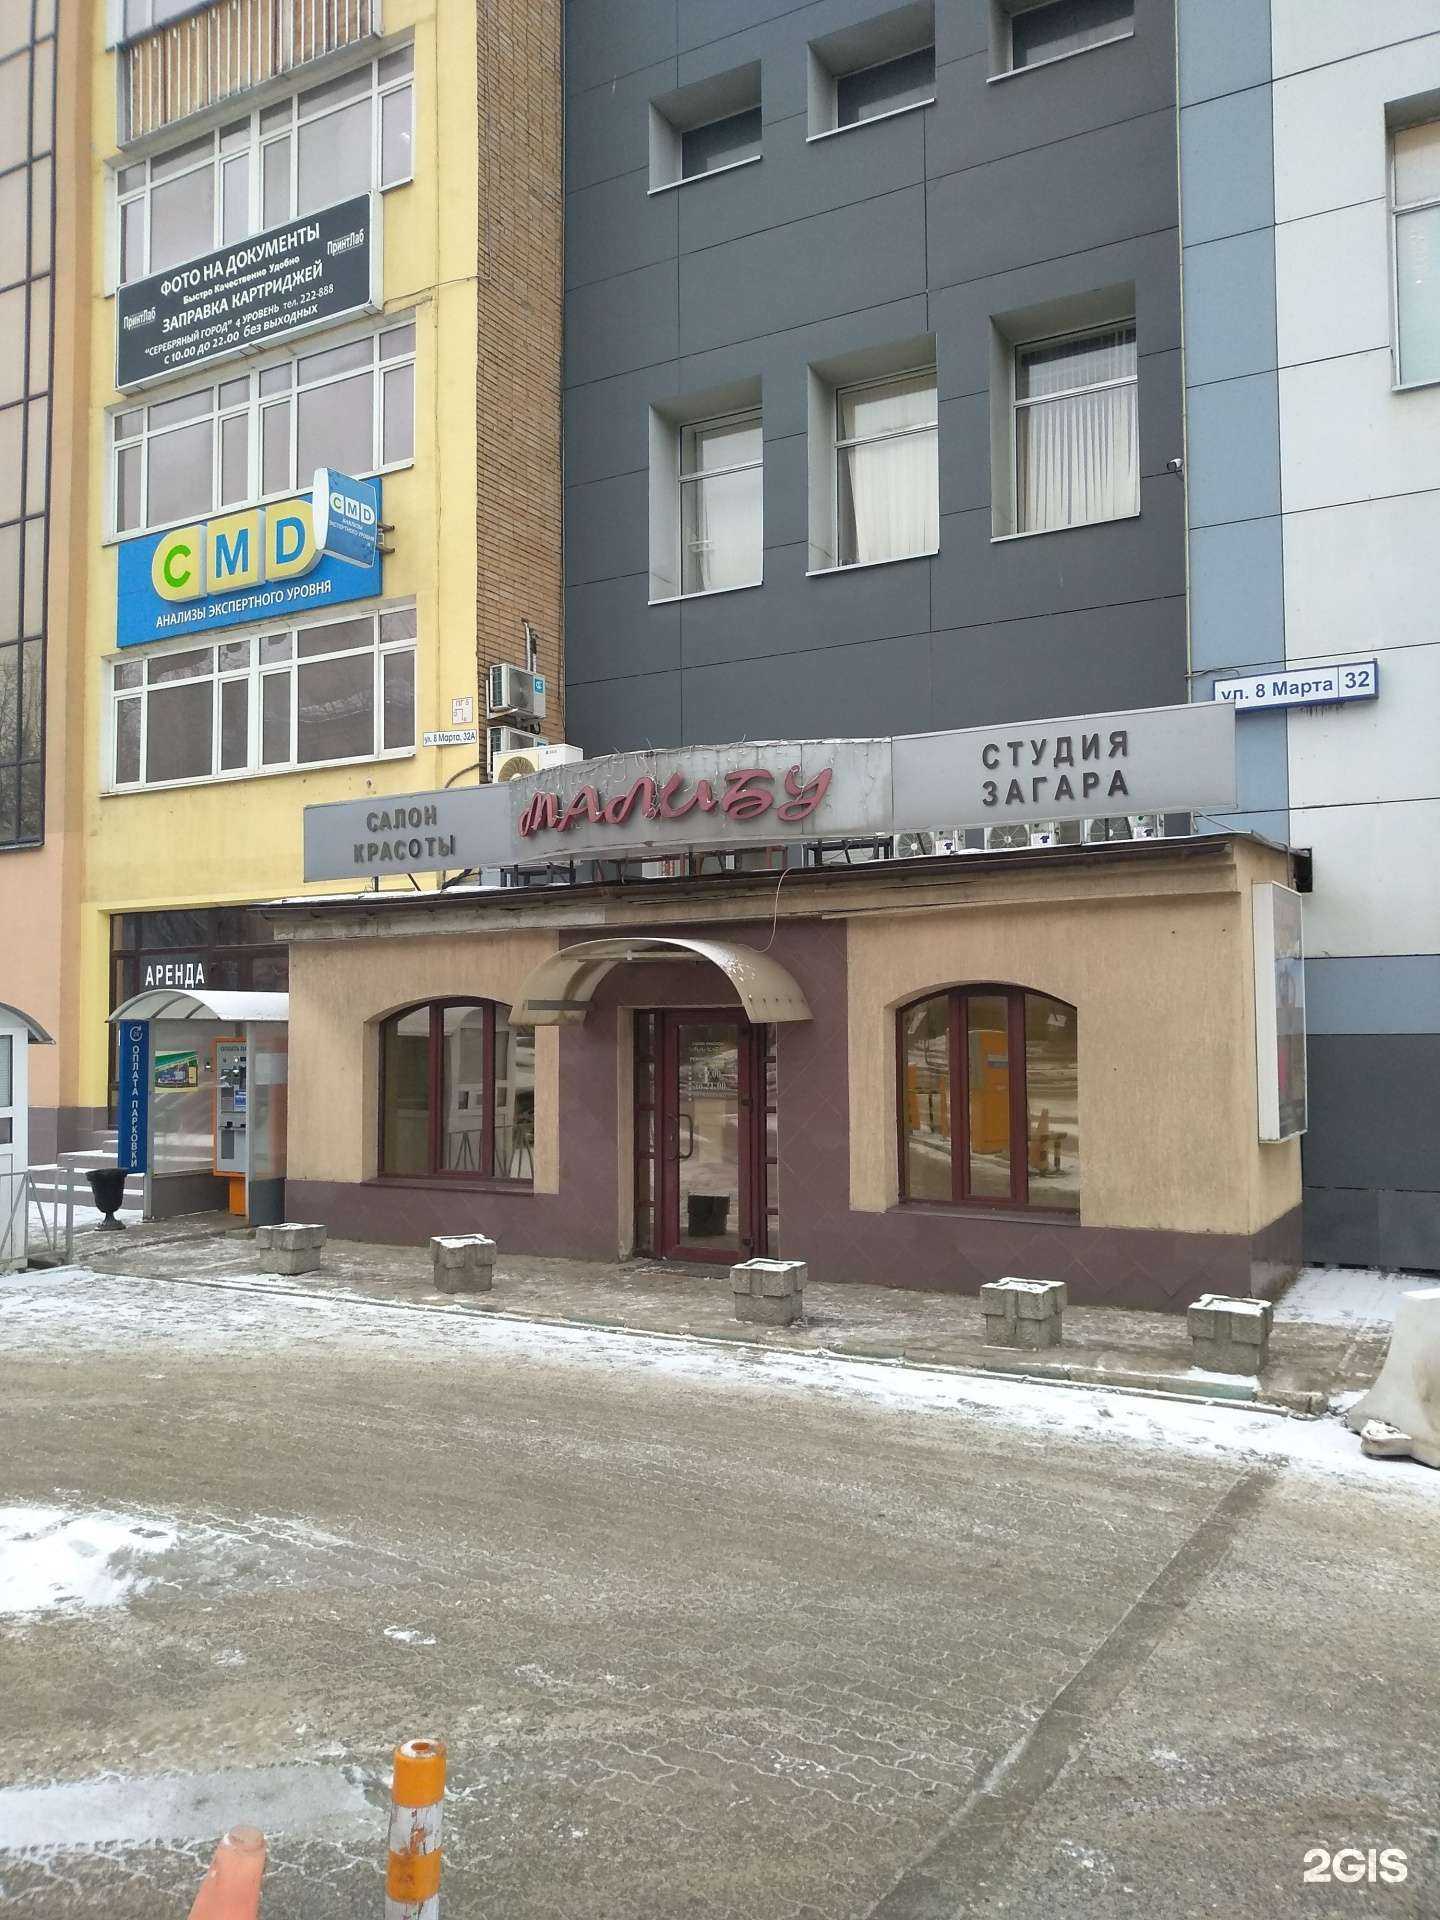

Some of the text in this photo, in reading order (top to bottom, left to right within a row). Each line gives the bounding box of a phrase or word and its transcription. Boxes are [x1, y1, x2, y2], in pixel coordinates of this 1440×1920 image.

[160, 222, 320, 296] ФОТО НА ДОКУМЕНТЫ
[327, 228, 365, 255] ПринтЛаб
[162, 260, 323, 333] ЗАПРАВКА КАРТРИДЖЕЙ
[183, 256, 300, 305] Быстро Качественно Удобно
[123, 306, 156, 330] ПринтЛаб
[242, 304, 280, 324] УРОВЕНЬ
[283, 299, 299, 310] тел.
[300, 283, 334, 304] 222-888
[172, 346, 196, 362] 10.00
[212, 331, 240, 348] 22.00
[243, 324, 262, 338] без
[332, 494, 373, 523] CMD
[160, 512, 308, 592] CMD
[156, 579, 332, 629] АНАЛИЗЫ ЭКСПЕРТНОГО УРОВНЯ
[1256, 683, 1266, 698] 8
[1272, 678, 1334, 699] Марта
[1344, 670, 1370, 690] 32
[463, 731, 476, 741] 32А
[982, 730, 1129, 770] СТУДИЯ
[982, 770, 1129, 807] ЗАГАРА
[366, 804, 438, 834] САЛОН
[353, 834, 456, 864] КРАСОТЫ
[145, 963, 206, 989] АРЕНДА
[130, 1045, 141, 1168] ОПЛАТА ПАРКОВКИ
